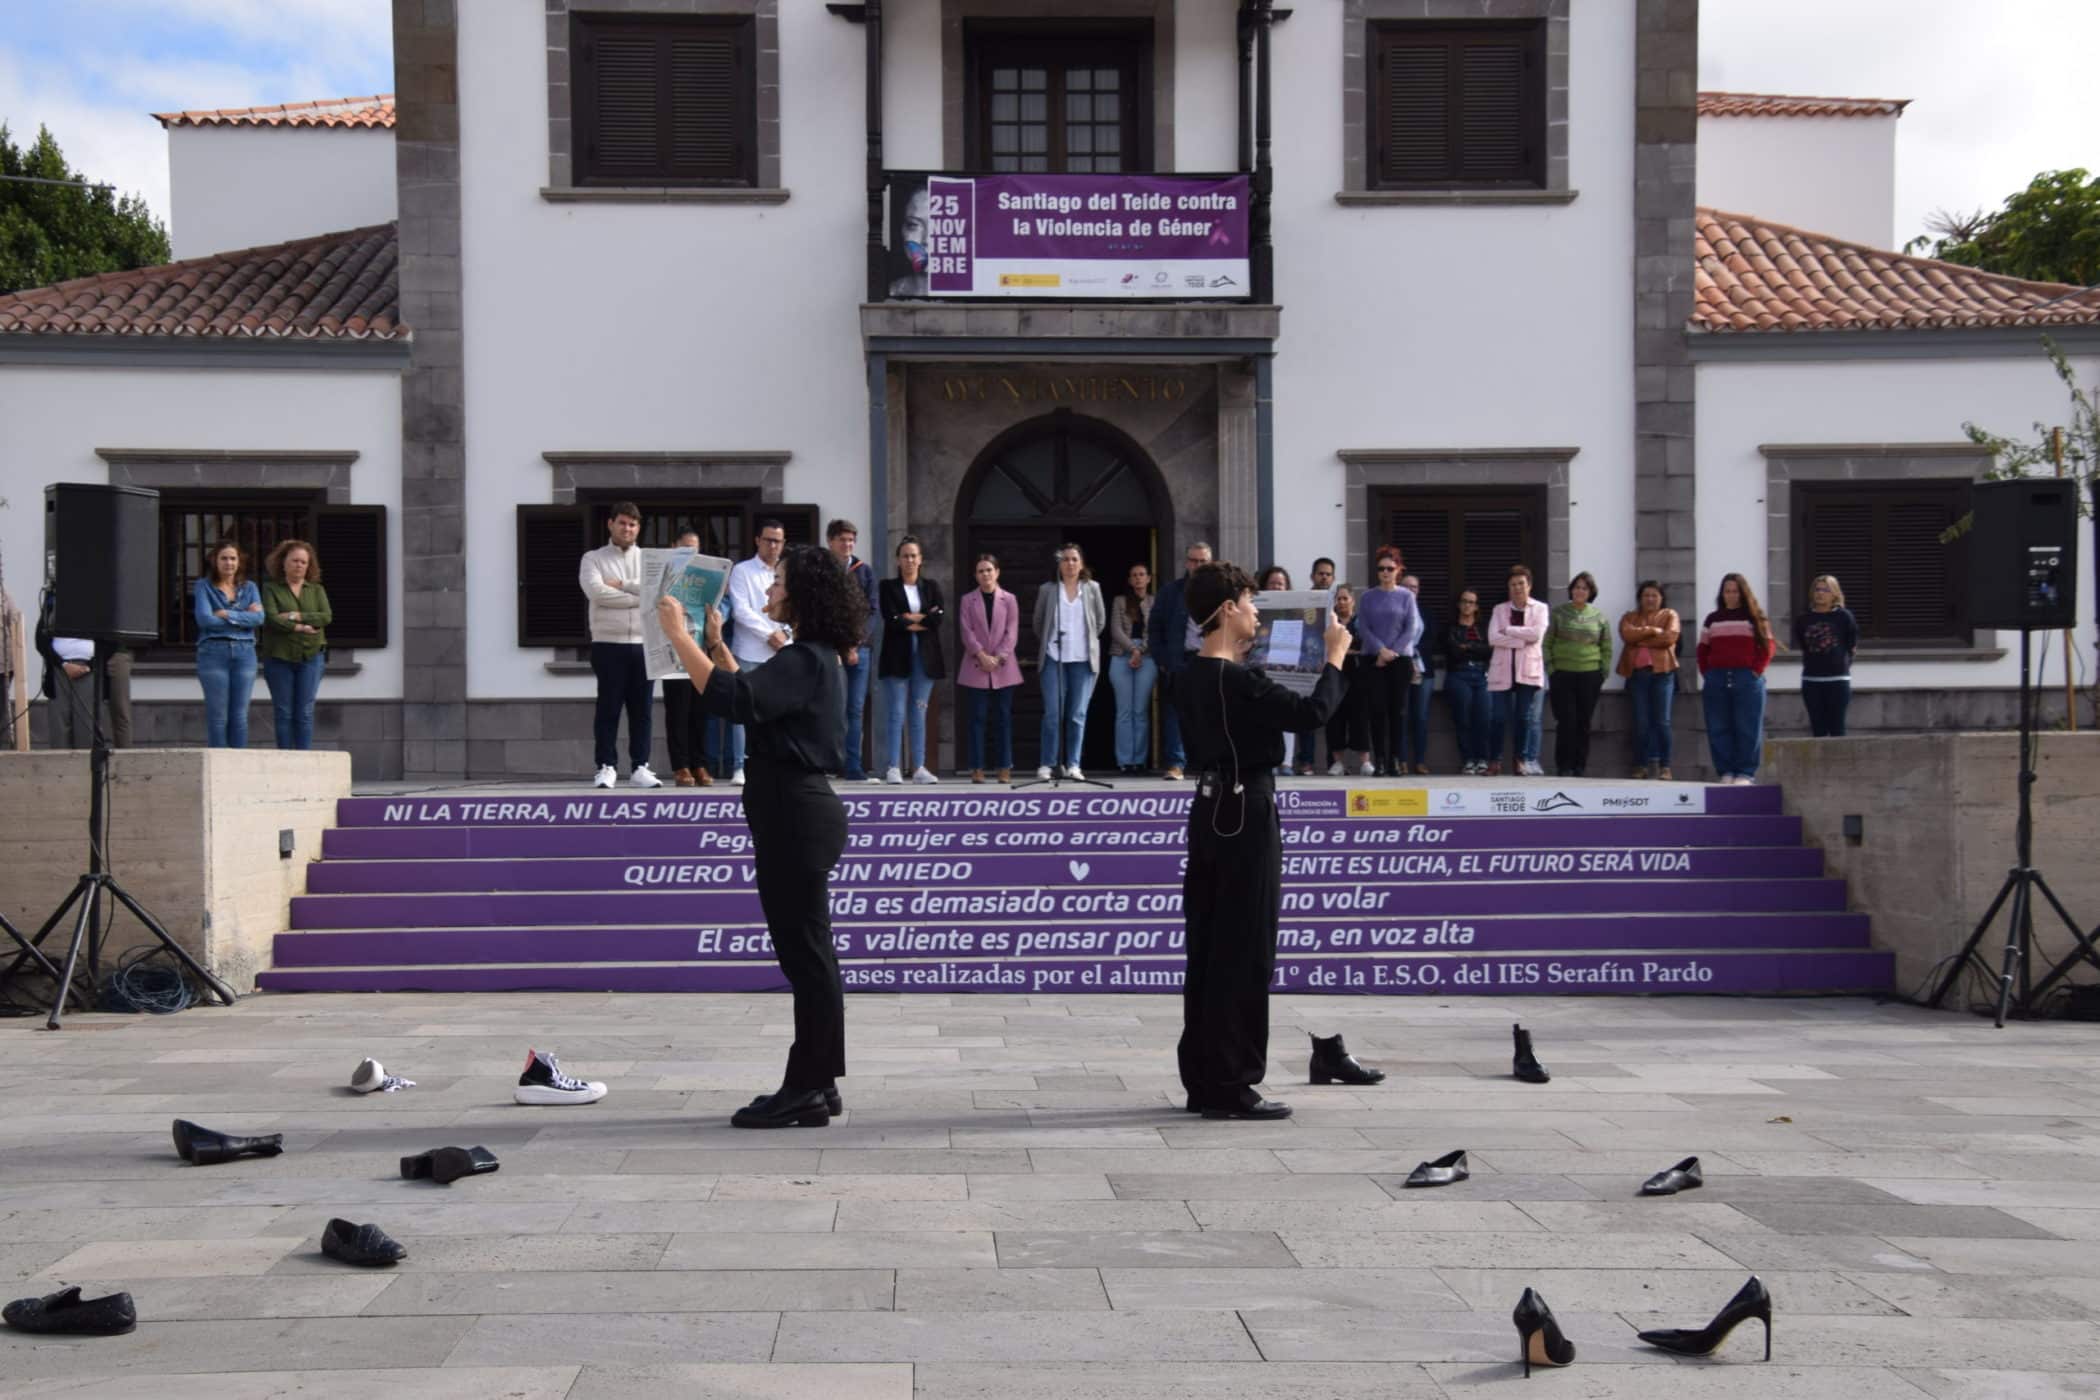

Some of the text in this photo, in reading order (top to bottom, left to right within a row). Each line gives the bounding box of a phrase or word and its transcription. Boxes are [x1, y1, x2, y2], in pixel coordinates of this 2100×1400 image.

[930, 195, 959, 215] 25
[998, 192, 1237, 213] Santiago del Teide contra
[929, 218, 966, 235] NOV
[1013, 218, 1031, 235] la
[1036, 218, 1123, 236] Violencia
[1129, 218, 1152, 236] de
[929, 257, 967, 274] BRE
[384, 804, 412, 821] NI
[419, 804, 451, 821] LA
[460, 803, 557, 823] TIERRA,
[564, 802, 592, 820] NI
[599, 802, 647, 819] LAS
[653, 801, 747, 821] MUJERE
[878, 799, 1041, 818] TERRITORIOS
[1048, 799, 1080, 816] DE
[1496, 803, 1526, 812] TEIDE
[880, 830, 956, 851] mujer
[961, 830, 989, 846] es
[995, 830, 1063, 846] como
[1070, 826, 1189, 846] arrancarl
[1331, 829, 1345, 843] a
[1354, 828, 1399, 843] una
[1407, 824, 1452, 843] flor
[624, 865, 733, 886] QUIERO
[828, 863, 872, 881] SIN
[879, 862, 973, 881] MIEDO
[1348, 856, 1372, 875] ES
[1377, 855, 1453, 877] LUCHA,
[1458, 856, 1483, 873] EL
[1489, 854, 1573, 873] FUTURO
[1578, 850, 1634, 872] SERÁ
[1640, 853, 1691, 871] VIDA
[828, 890, 866, 916] ida
[875, 897, 903, 915] es
[910, 890, 1055, 914] demasiado
[1062, 890, 1132, 913] corta
[1282, 893, 1314, 910] no
[1321, 887, 1390, 910] volar
[698, 930, 723, 953] El
[728, 931, 774, 953] act
[865, 928, 973, 952] valiente
[980, 933, 1009, 950] es
[1015, 932, 1110, 956] pensar
[1114, 931, 1163, 956] por
[1330, 928, 1362, 946] en
[1370, 928, 1417, 946] voz
[1423, 920, 1475, 945] alta
[902, 963, 1026, 986] realizadas
[1032, 968, 1075, 990] por
[1081, 964, 1103, 985] el
[1109, 964, 1185, 986] alumn
[1274, 966, 1299, 985] 1º
[1308, 965, 1337, 986] de
[1344, 967, 1365, 986] la
[1373, 964, 1446, 985] E.S.O.
[1453, 963, 1491, 984] del
[1497, 963, 1540, 984] IES
[1547, 961, 1635, 983] Serafín
[1643, 961, 1713, 982] Pardo
